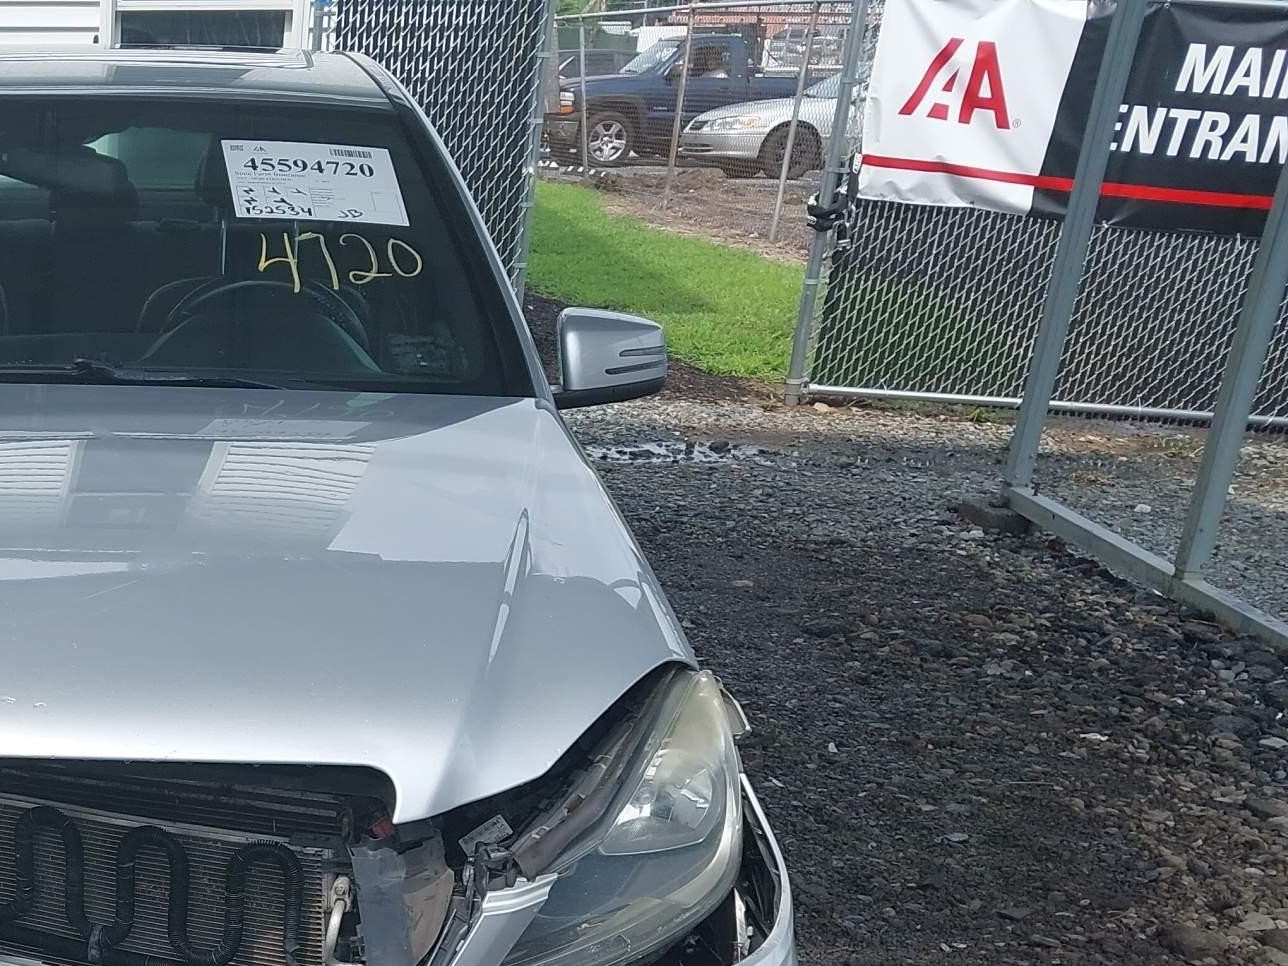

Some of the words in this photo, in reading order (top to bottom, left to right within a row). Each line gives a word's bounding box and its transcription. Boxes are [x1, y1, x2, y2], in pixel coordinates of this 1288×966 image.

[1175, 43, 1288, 99] MAI
[243, 157, 374, 178] 45594720
[244, 205, 313, 217] 152534
[337, 208, 364, 219] JB
[258, 231, 423, 293] 4720
